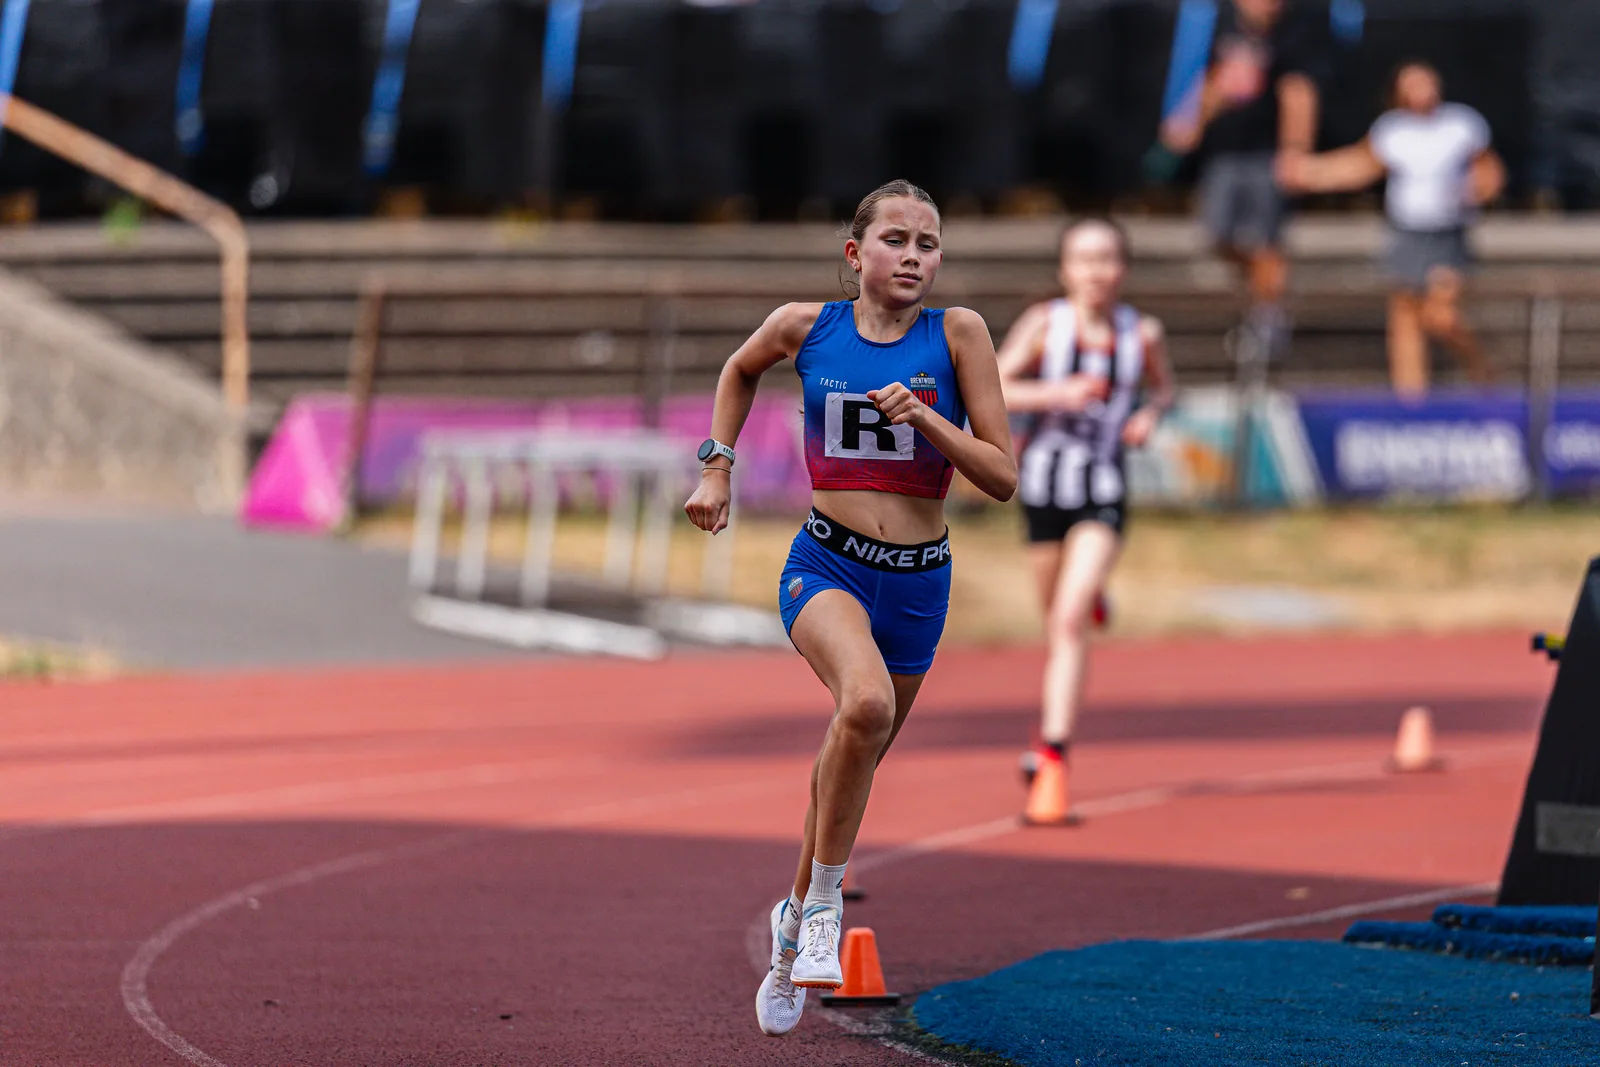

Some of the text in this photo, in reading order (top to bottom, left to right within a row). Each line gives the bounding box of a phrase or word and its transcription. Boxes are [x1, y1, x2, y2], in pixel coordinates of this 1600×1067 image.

[820, 377, 847, 389] TACTIC
[842, 400, 898, 451] R
[843, 536, 918, 567] NIKE
